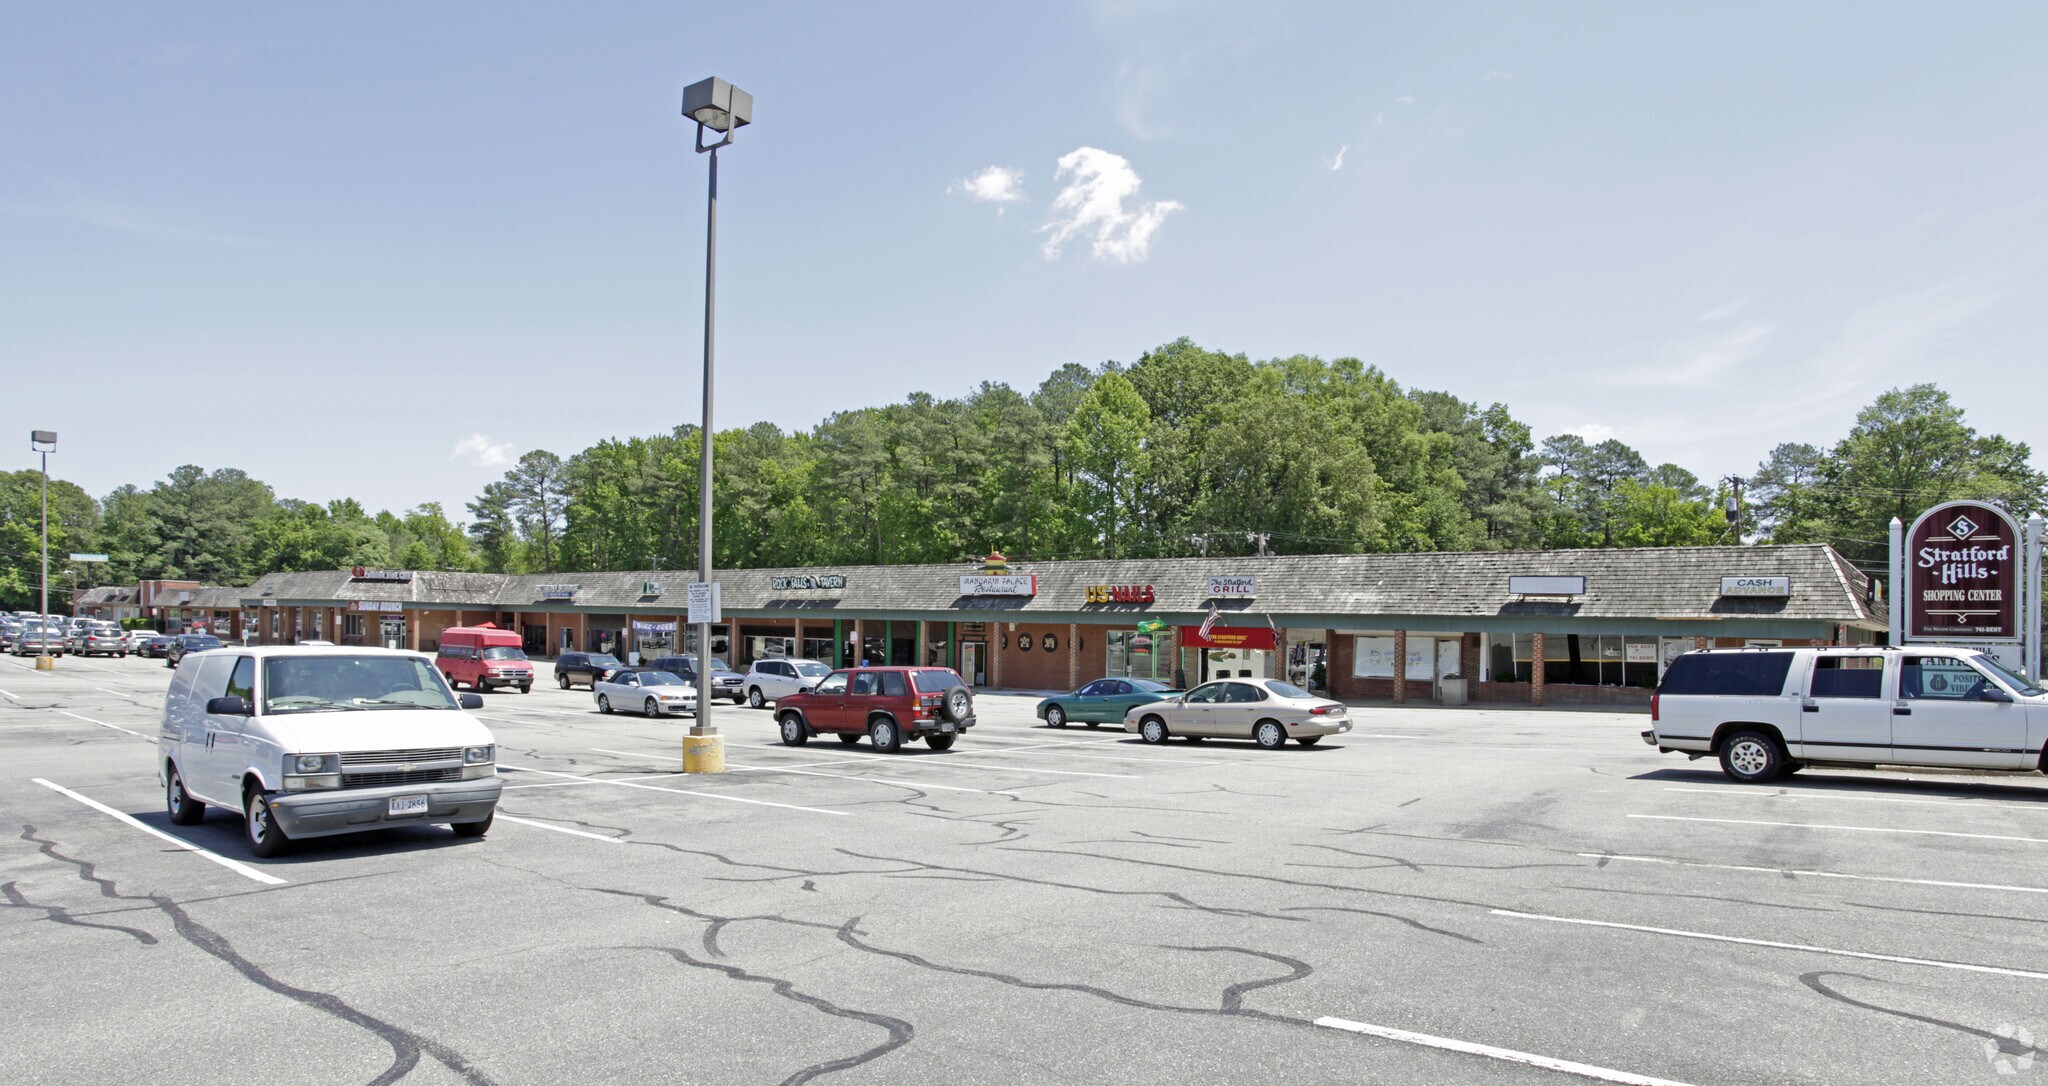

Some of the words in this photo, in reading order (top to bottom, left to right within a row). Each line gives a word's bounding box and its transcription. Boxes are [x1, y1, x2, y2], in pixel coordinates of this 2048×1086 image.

[1955, 521, 1970, 535] S
[1918, 545, 2011, 568] Stratford
[1941, 562, 1989, 585] Hills
[772, 577, 789, 590] ROCK
[791, 576, 807, 589] FALLS
[819, 575, 843, 588] TAVERN
[964, 577, 999, 585] MANDARIN
[1002, 577, 1028, 585] PALACE
[1210, 578, 1222, 586] The
[1223, 578, 1253, 586] Stratford
[974, 584, 1018, 593] Restaurant
[1085, 584, 1110, 603] US
[1112, 584, 1155, 603] NAILS
[1213, 585, 1250, 593] GRILL
[1725, 586, 1784, 594] ADVANCE
[1922, 589, 1965, 602] SHOPPING
[1967, 589, 2003, 602] CENTER
[358, 601, 379, 611] SUNDAY
